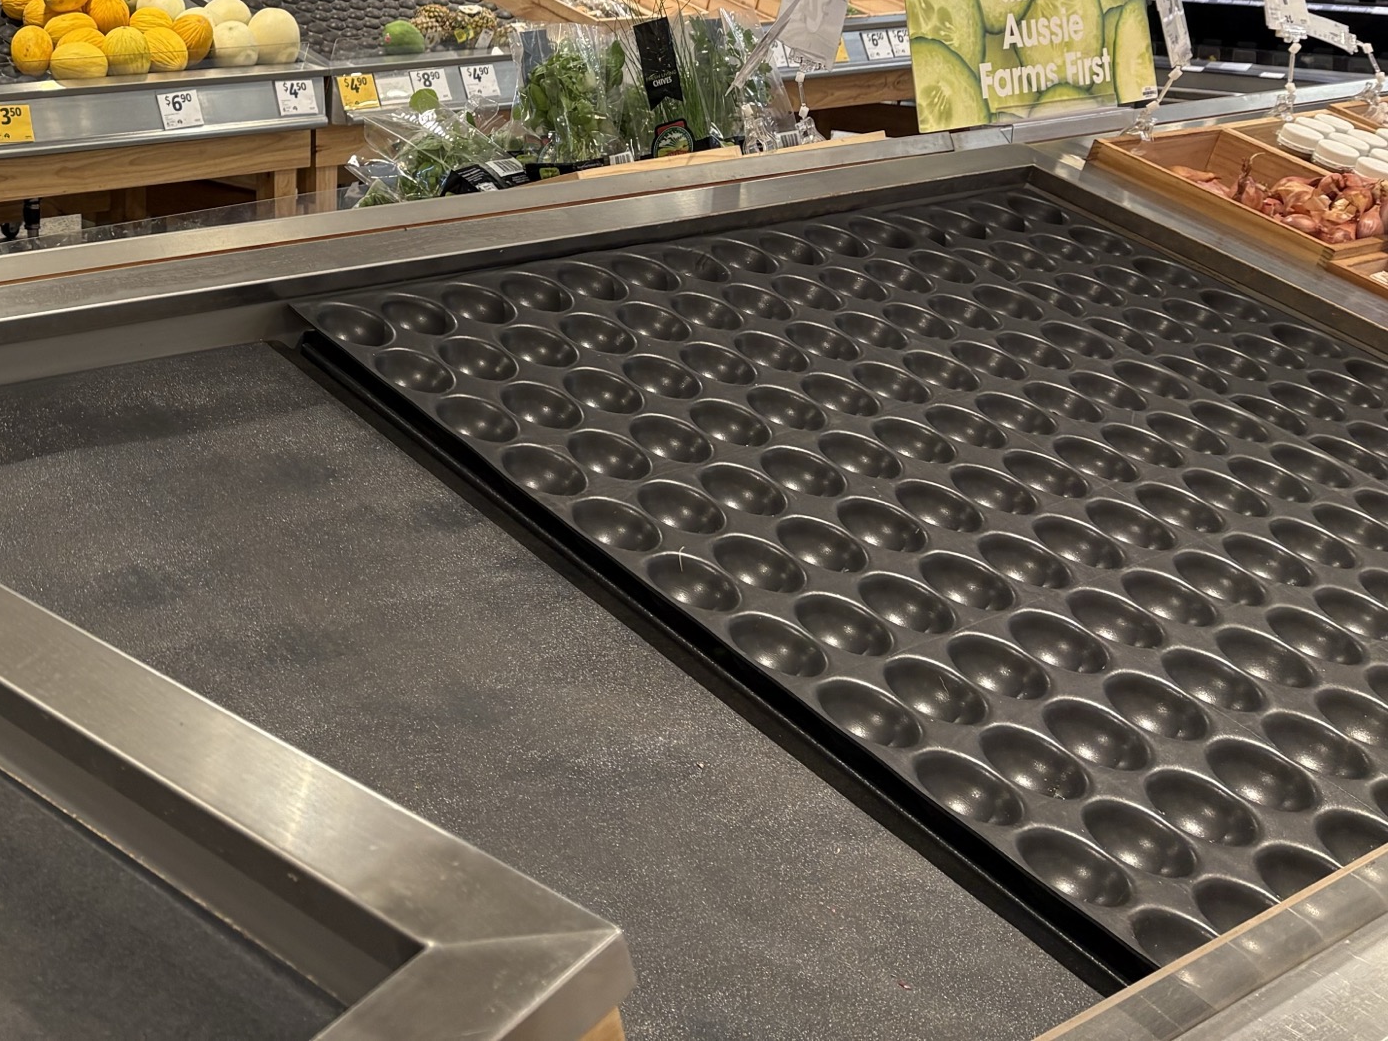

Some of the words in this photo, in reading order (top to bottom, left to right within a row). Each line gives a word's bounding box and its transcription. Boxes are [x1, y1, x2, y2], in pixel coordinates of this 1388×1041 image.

[1003, 9, 1084, 49] Aussie
[652, 76, 672, 87] CHIVES
[979, 62, 1058, 99] Farms
[1065, 48, 1111, 86] First
